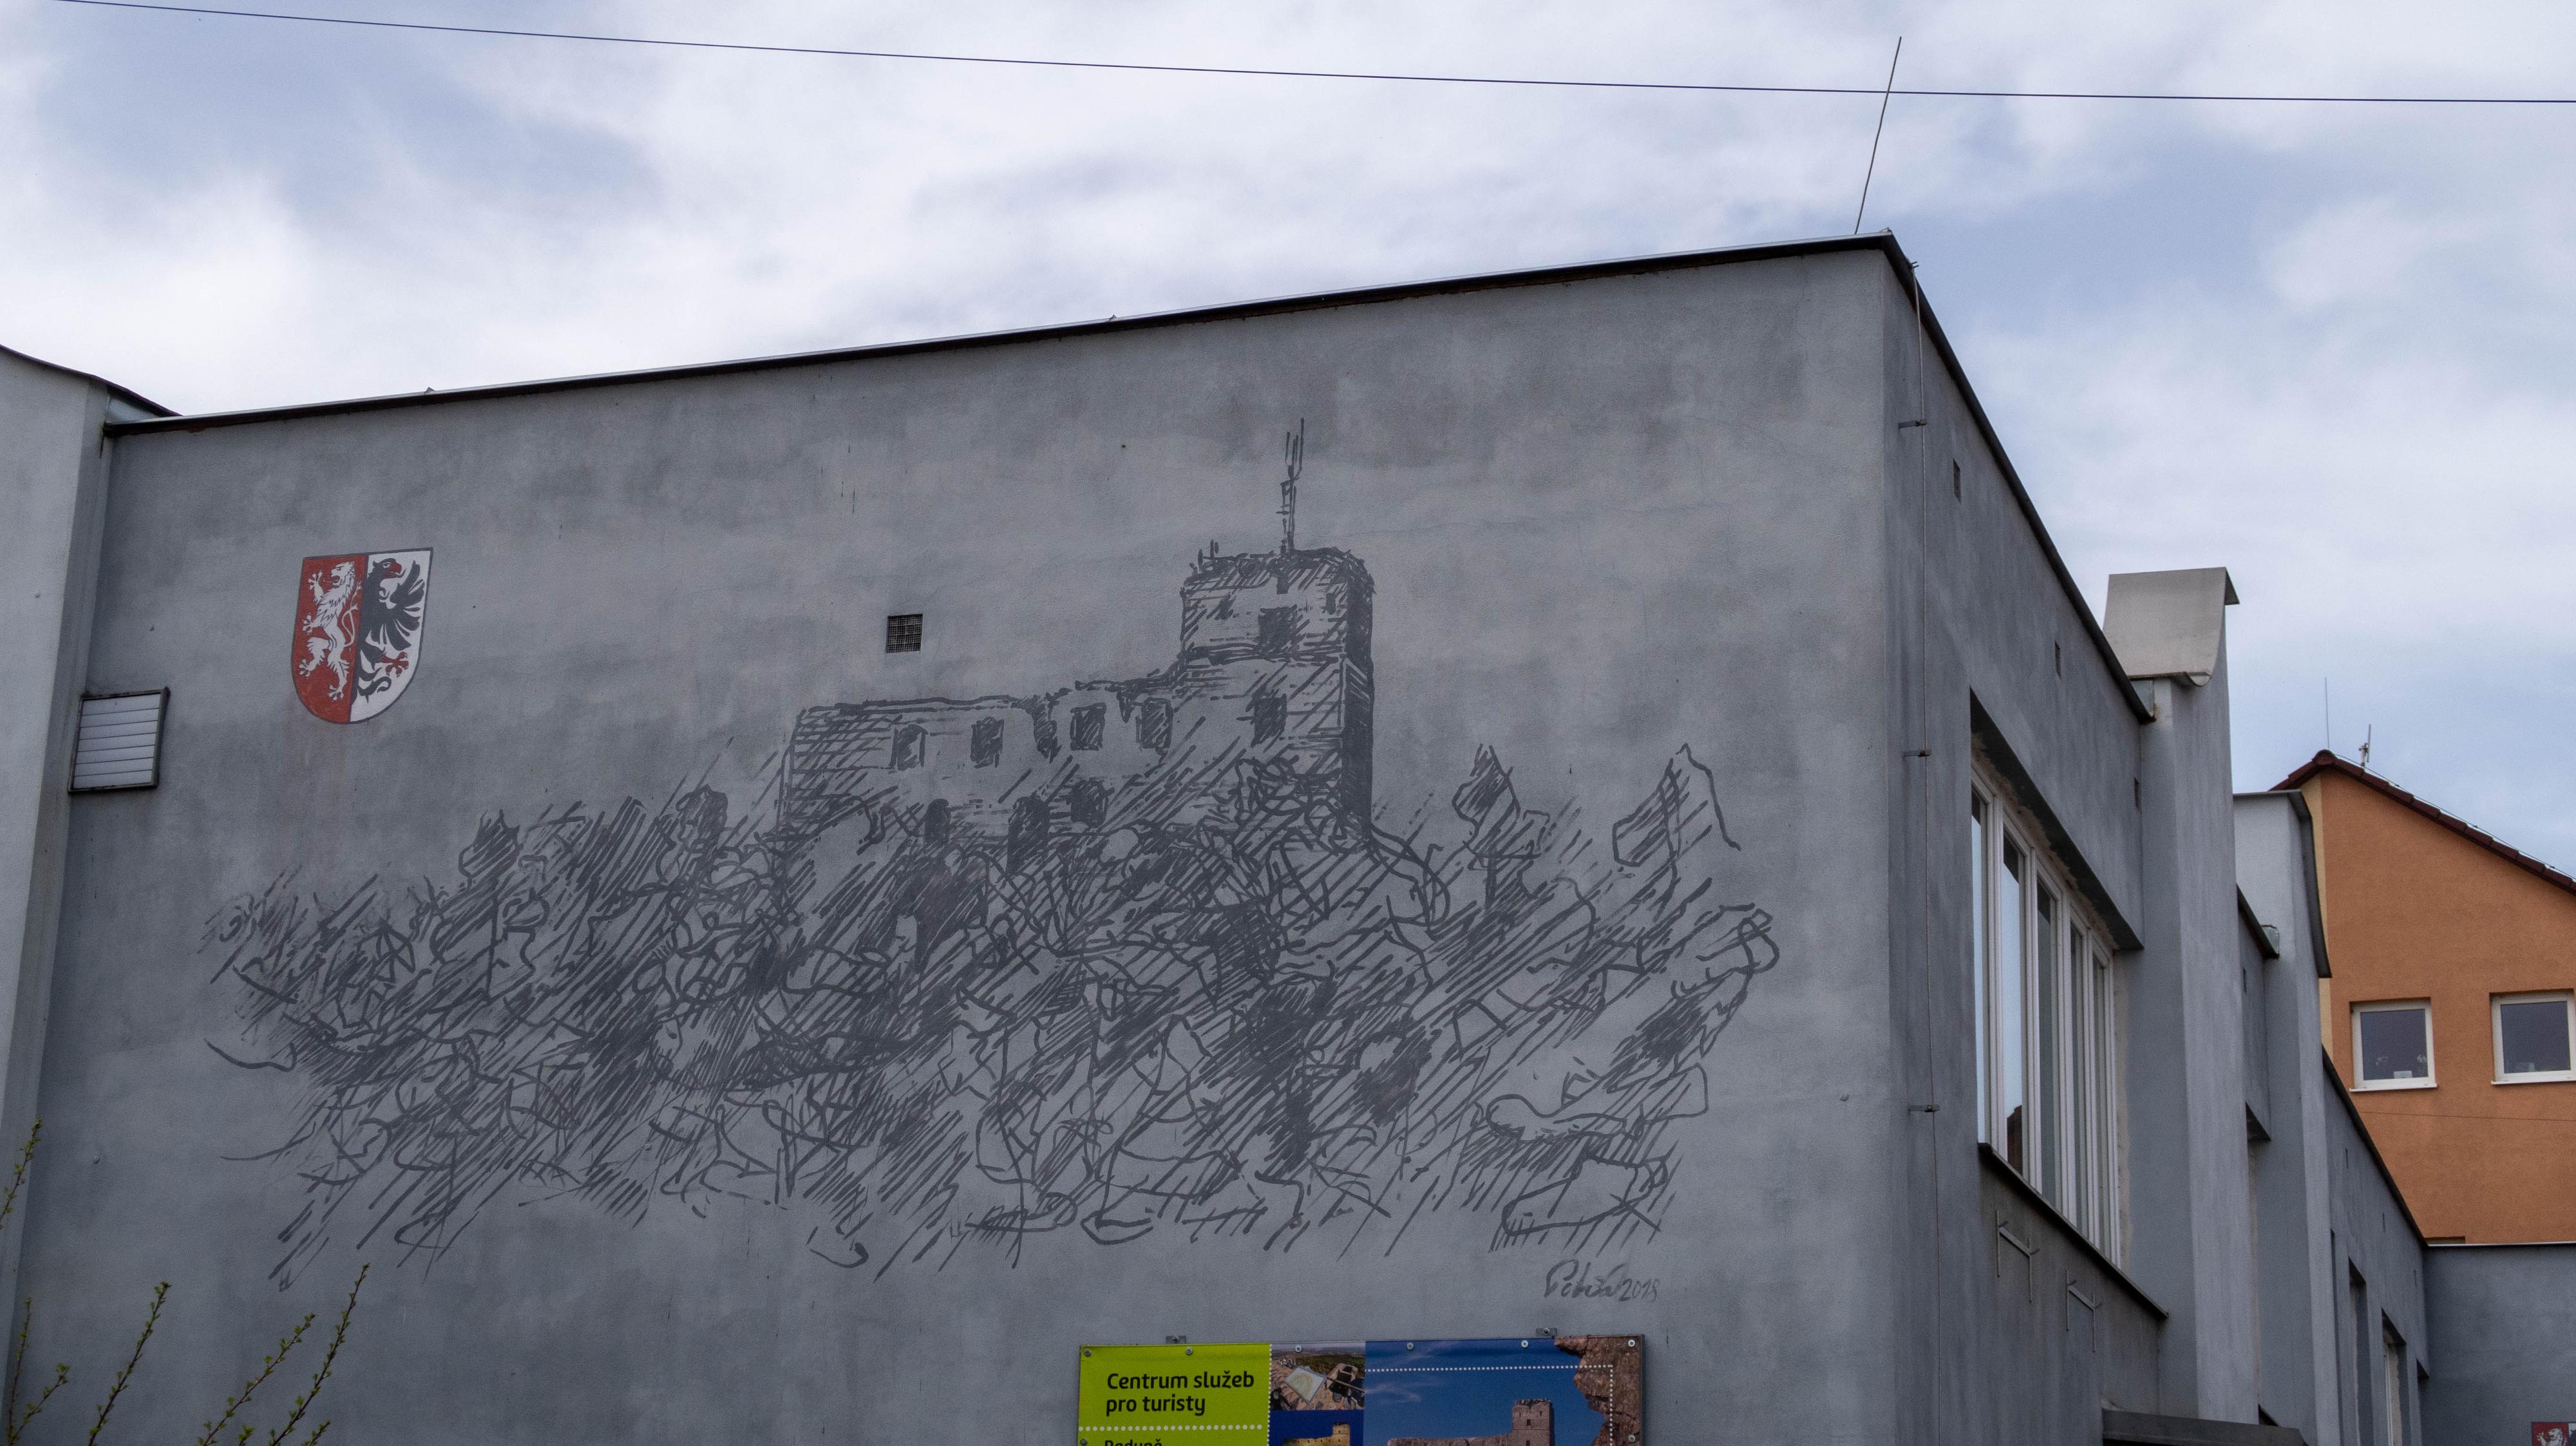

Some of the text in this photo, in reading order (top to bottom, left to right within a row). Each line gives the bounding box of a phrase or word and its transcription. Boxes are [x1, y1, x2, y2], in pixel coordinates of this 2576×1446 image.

[1107, 1370, 1255, 1390] Centrum služeb
[1106, 1393, 1206, 1417] pro turisty
